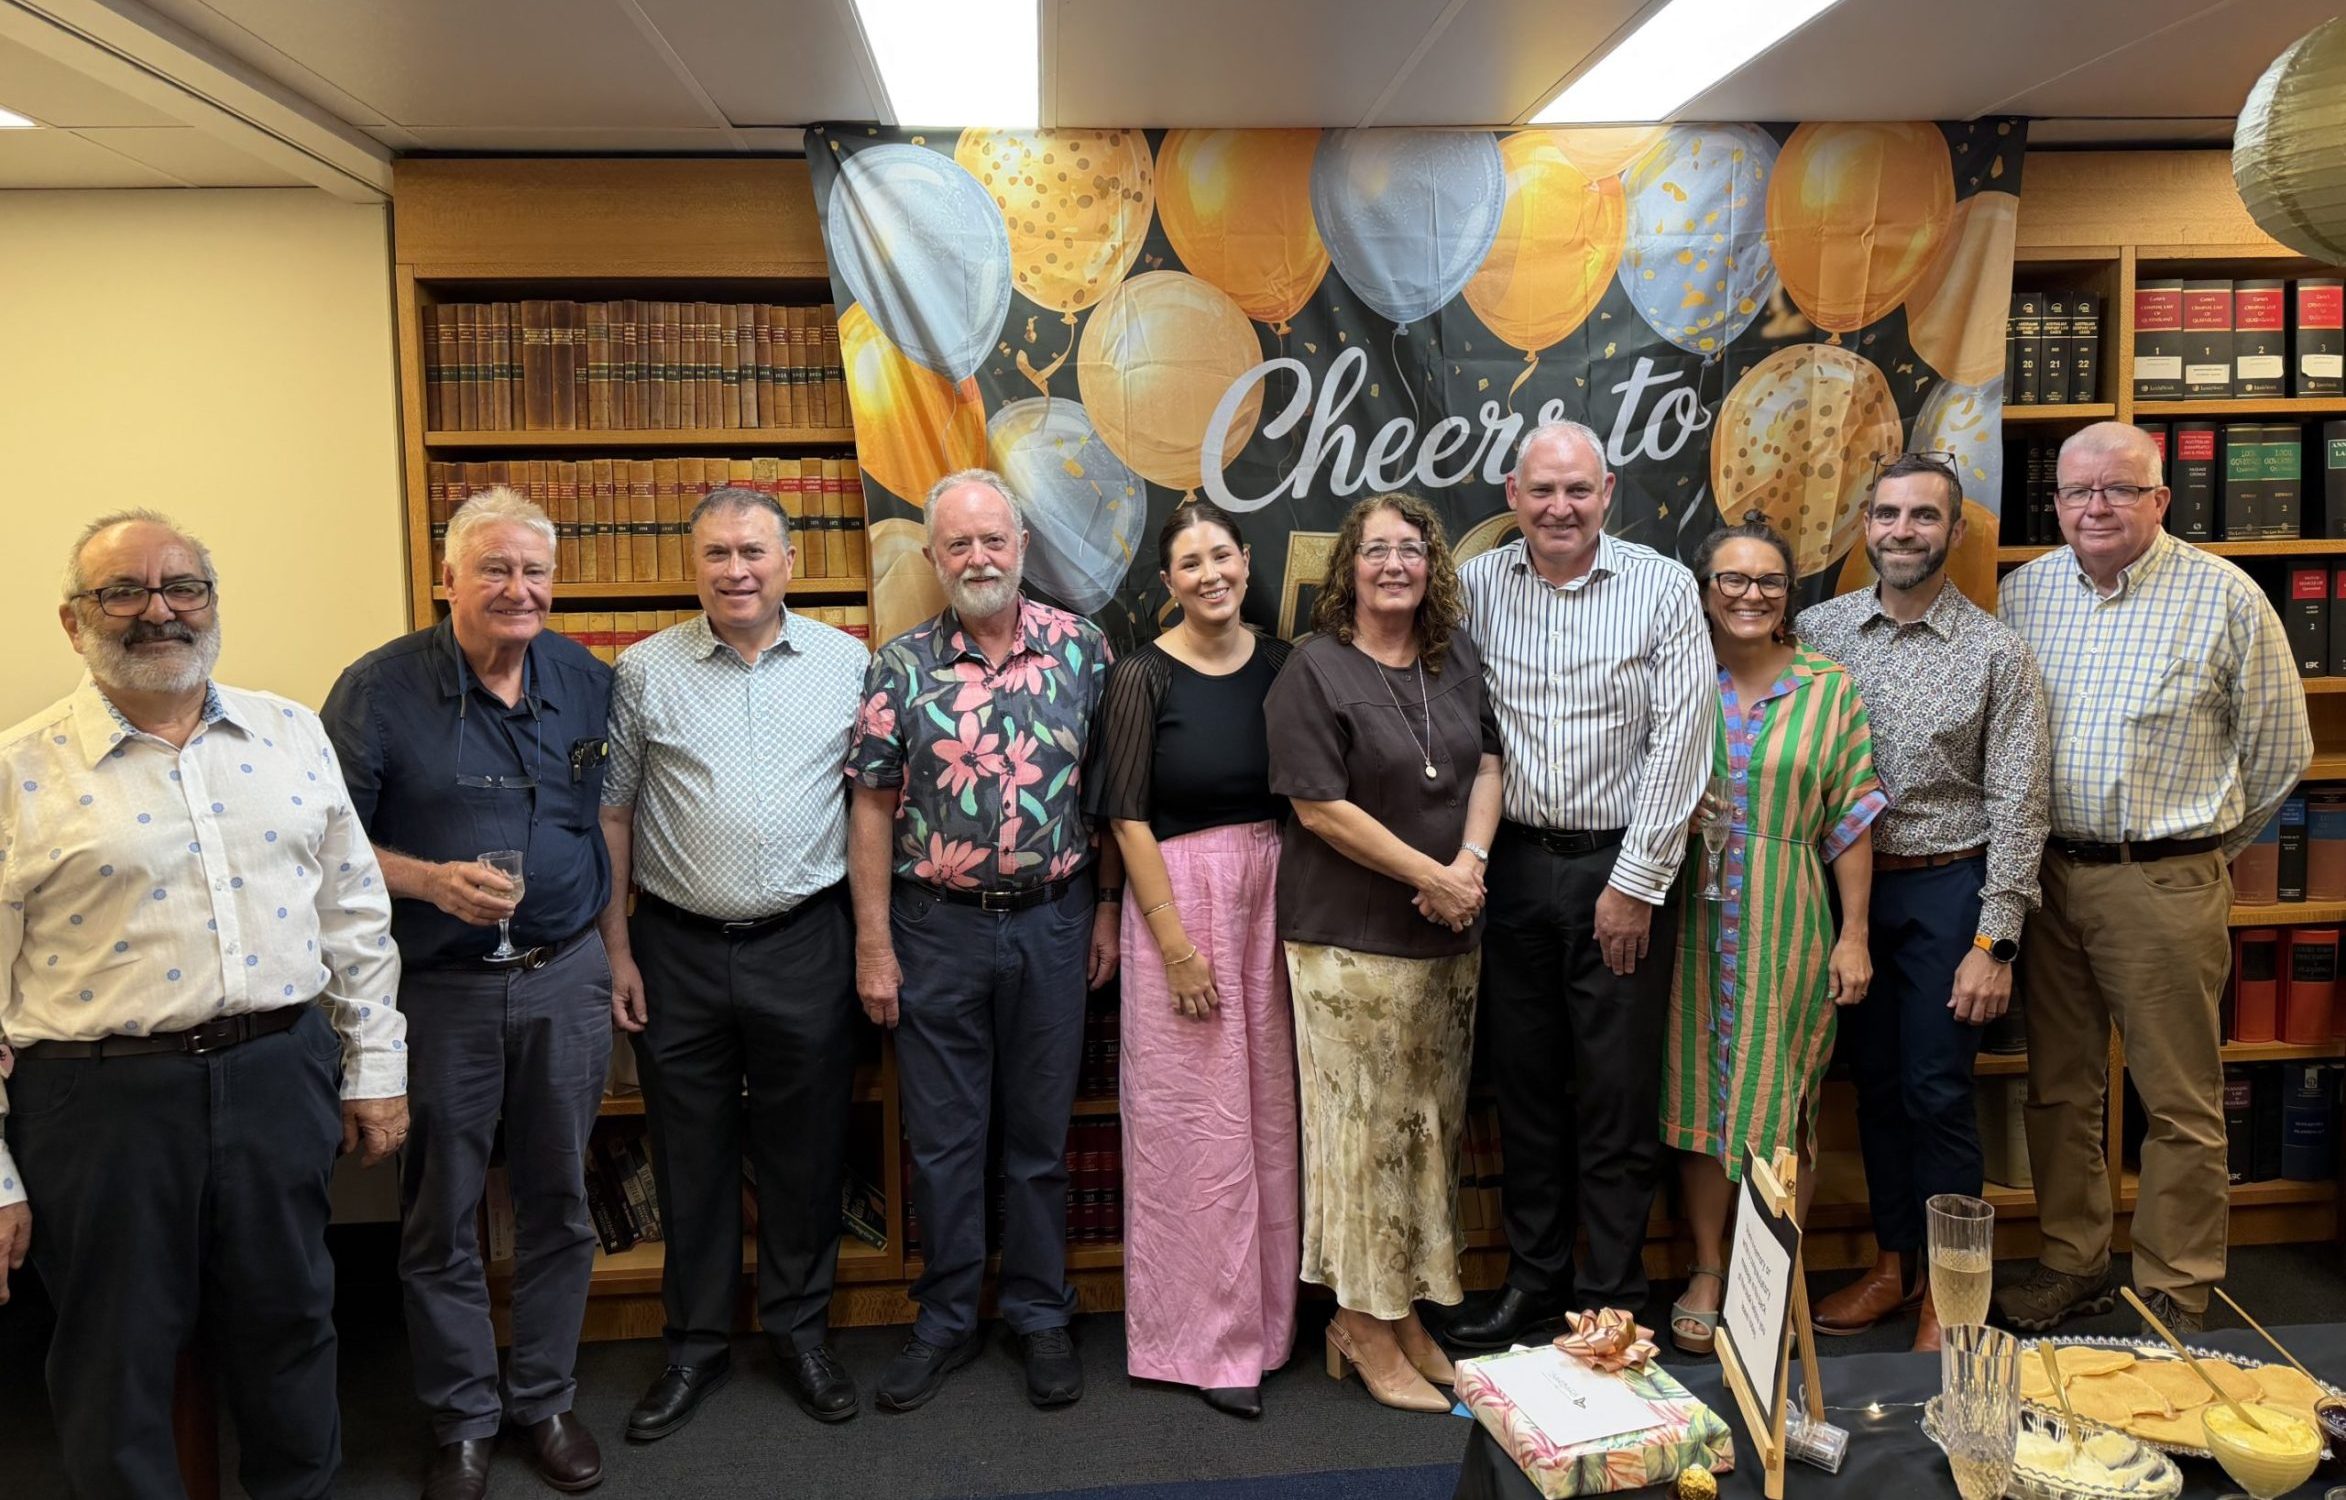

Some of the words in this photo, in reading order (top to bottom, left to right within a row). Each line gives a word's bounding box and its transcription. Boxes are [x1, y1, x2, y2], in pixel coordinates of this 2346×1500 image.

[2258, 345, 2265, 354] 2
[2320, 343, 2327, 352] 3
[2022, 360, 2033, 369] 20
[2050, 360, 2061, 369] 21
[2078, 359, 2090, 369] 22
[1606, 356, 1712, 467] to
